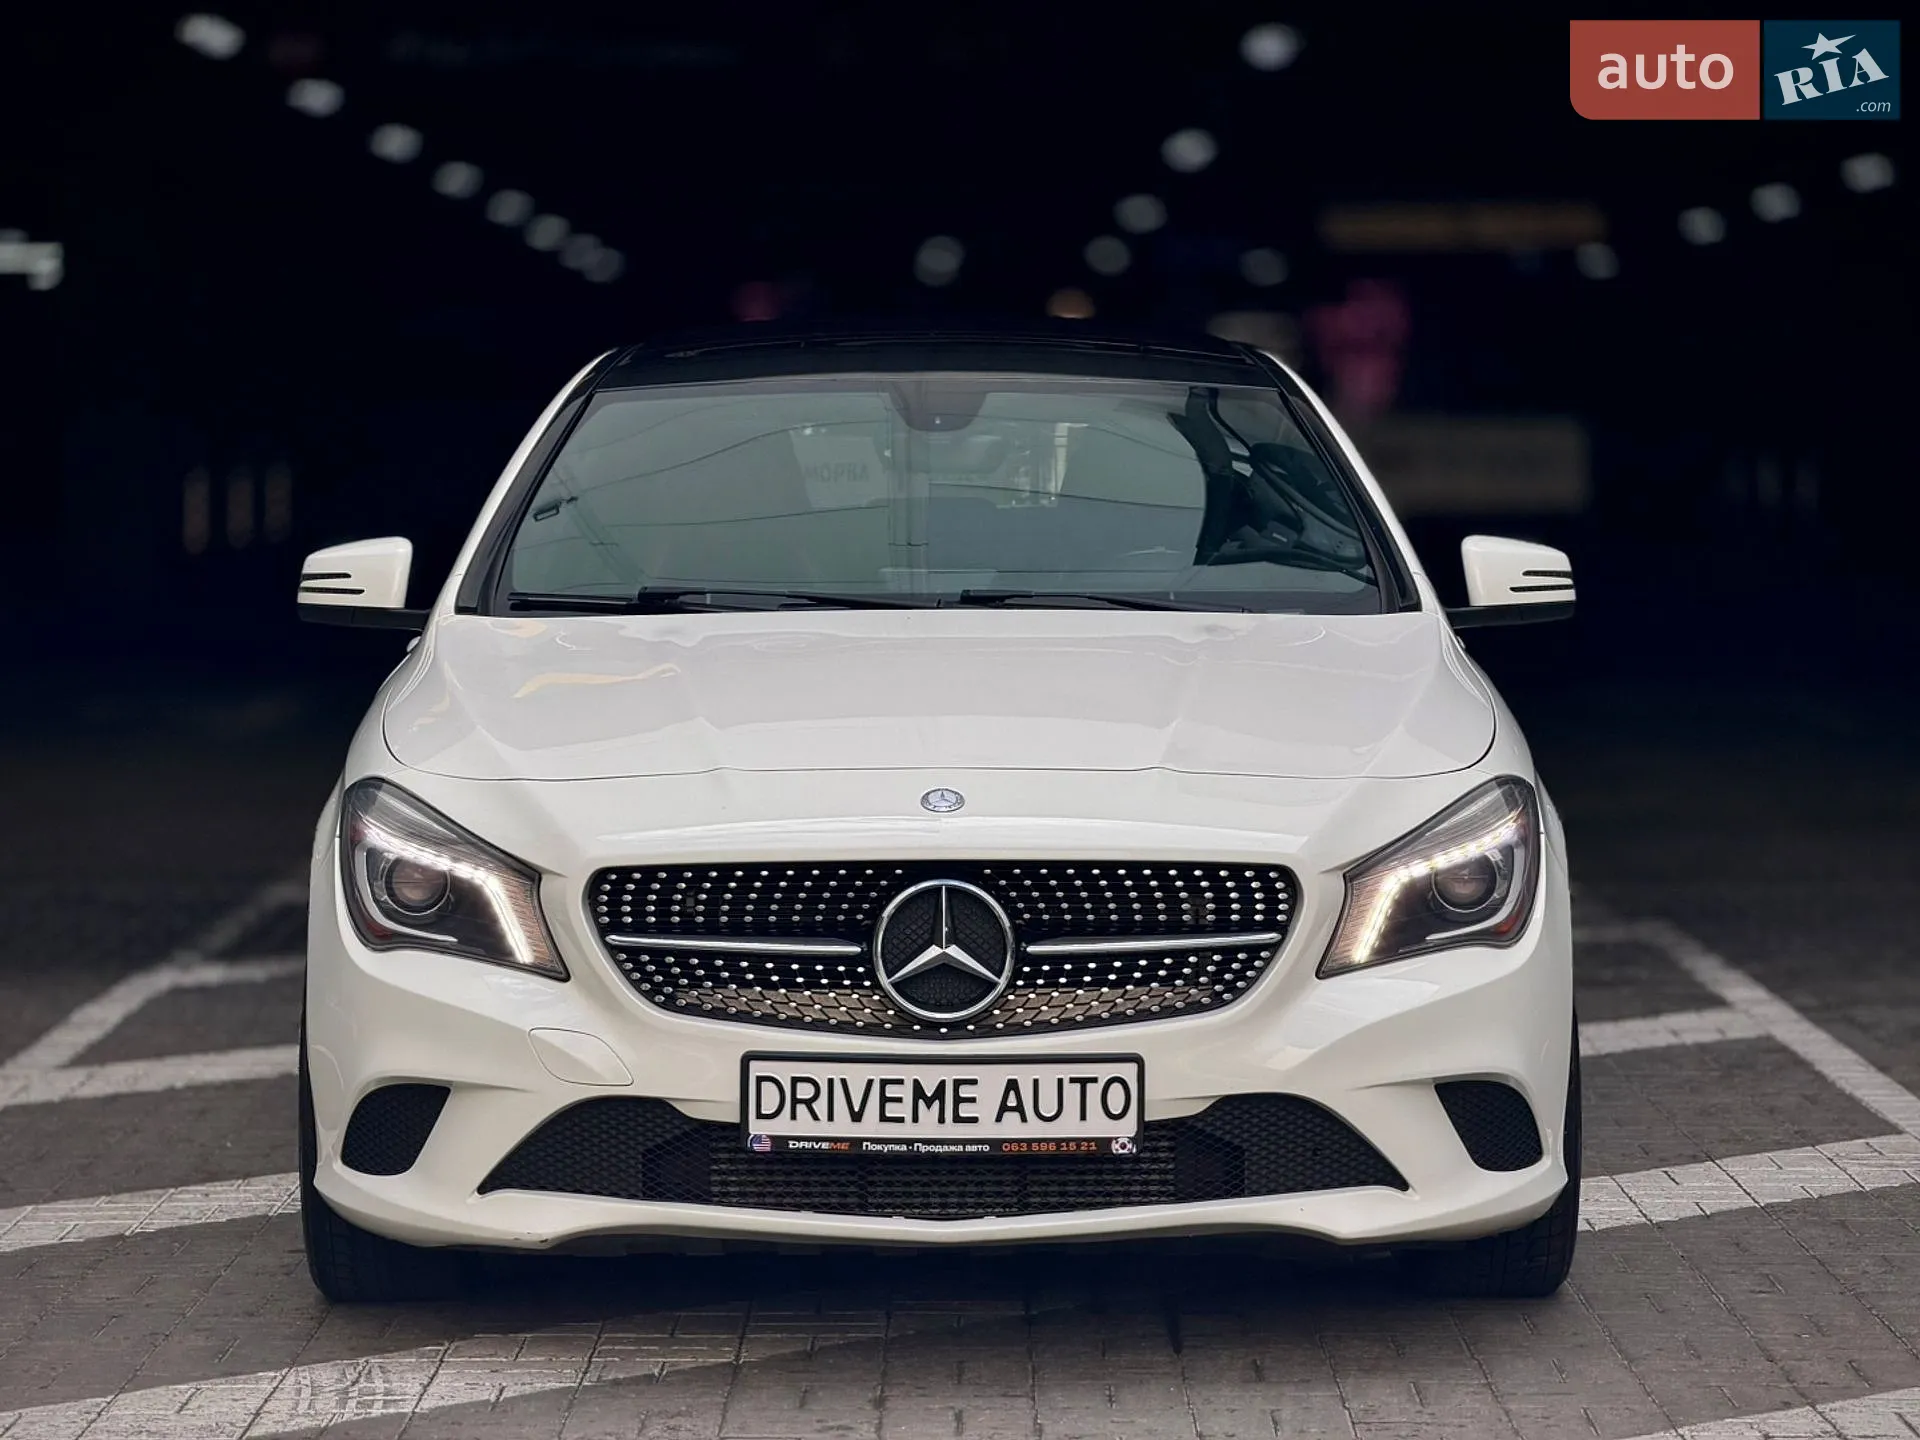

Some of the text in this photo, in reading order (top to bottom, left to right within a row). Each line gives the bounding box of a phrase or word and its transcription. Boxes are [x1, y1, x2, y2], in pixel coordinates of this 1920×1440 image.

[755, 1075, 1131, 1124] DRIVEME AUTO
[788, 1140, 850, 1150] DRIVEME
[862, 1141, 990, 1153] Покупка Продажа авто
[1060, 1142, 1077, 1151] 15
[1080, 1141, 1097, 1150] 21
